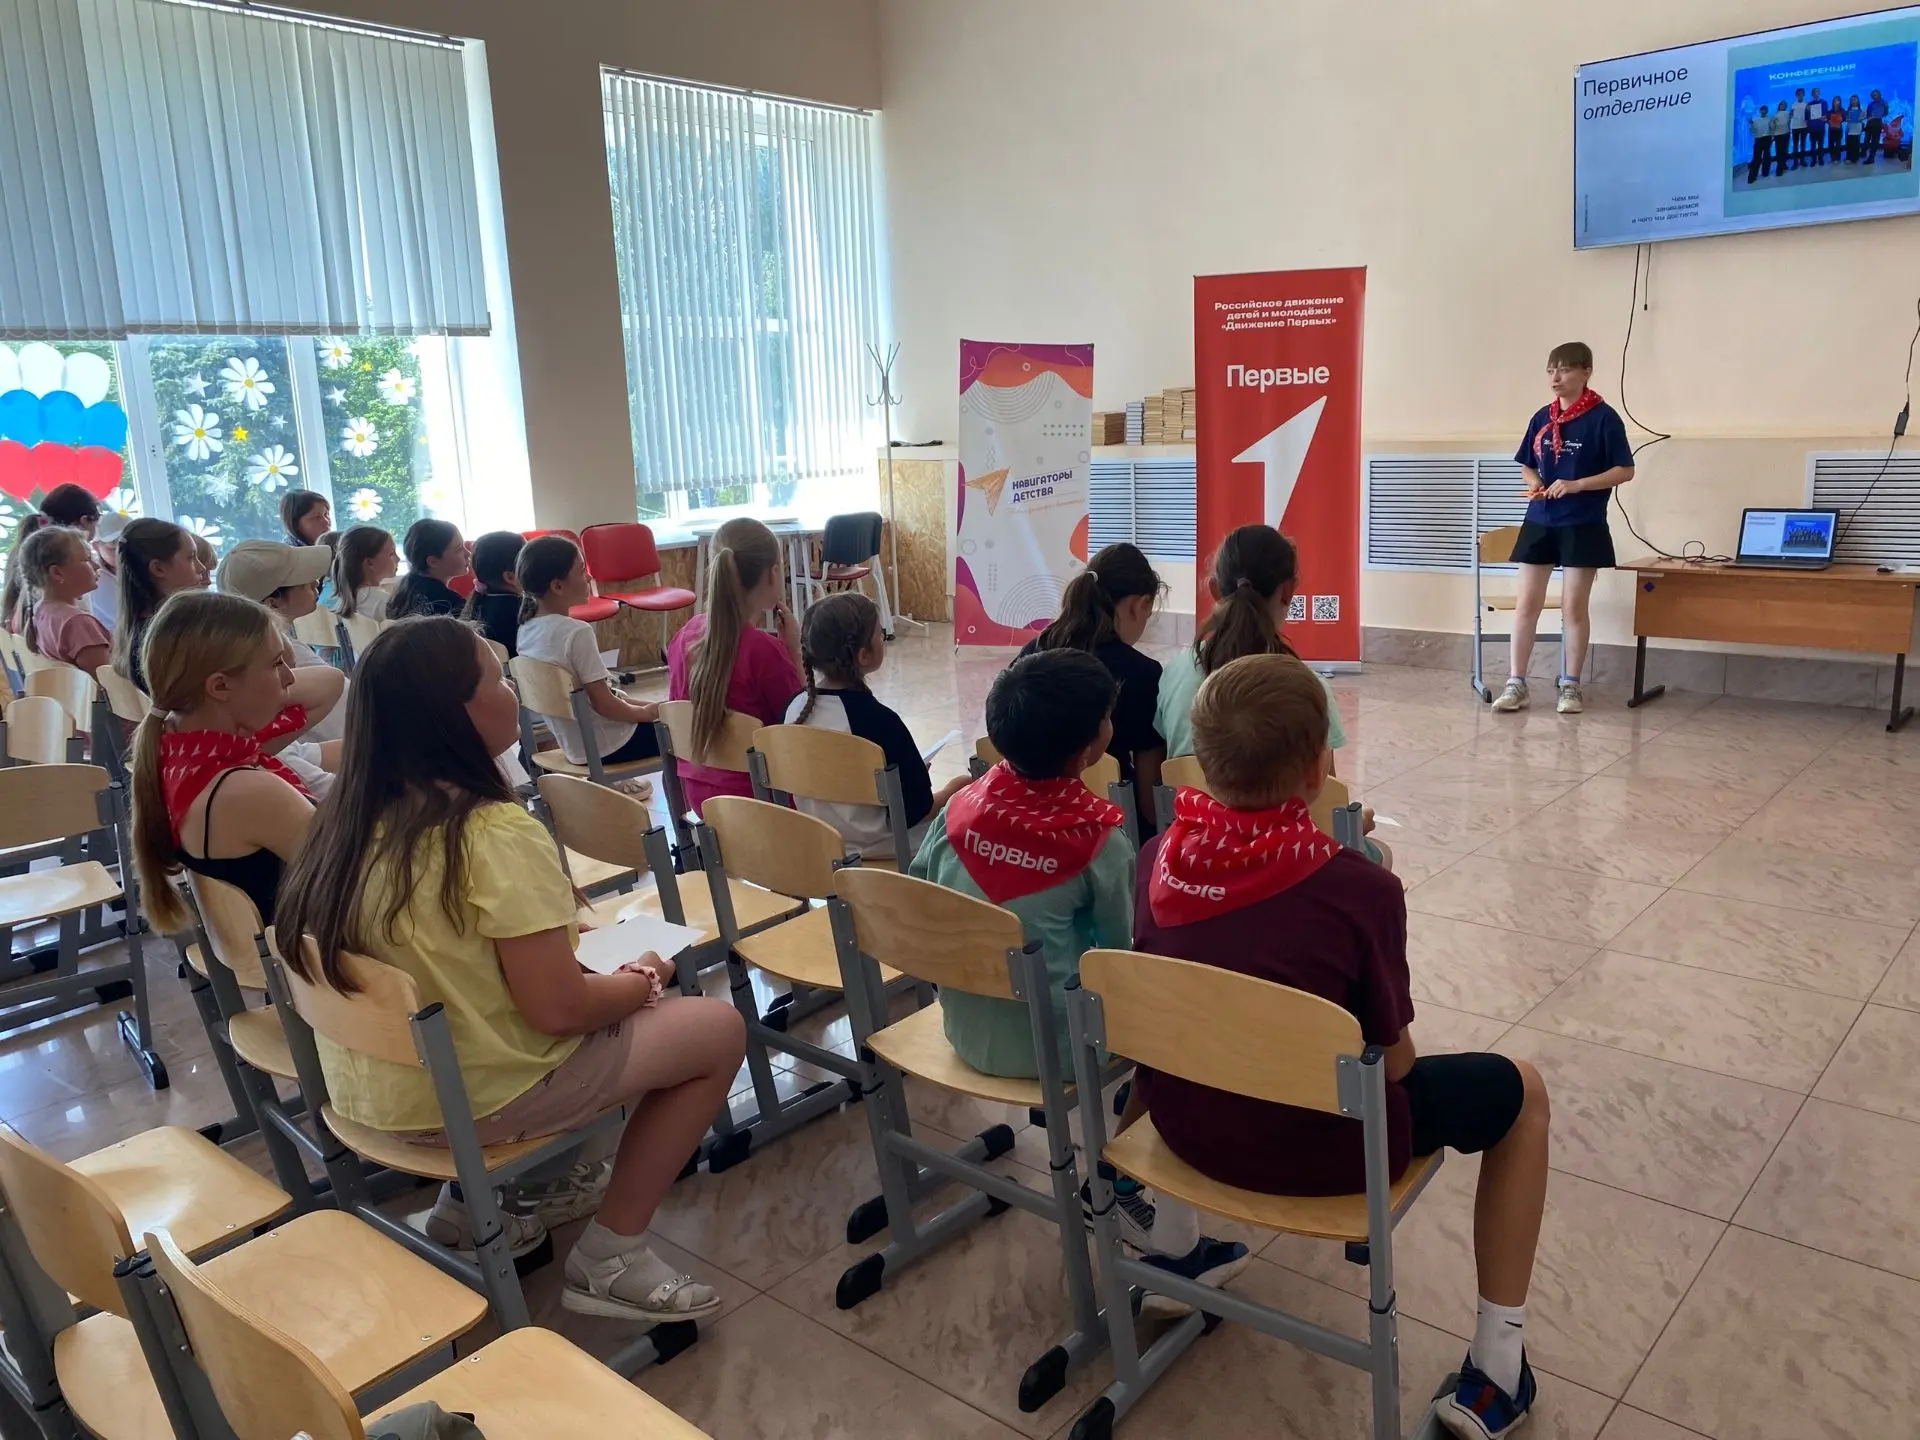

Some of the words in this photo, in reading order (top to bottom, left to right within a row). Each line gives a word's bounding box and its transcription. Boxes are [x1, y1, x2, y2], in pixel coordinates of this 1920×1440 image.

[1768, 63, 1856, 81] КОНФЕРЕНЦИЯ
[1583, 67, 1688, 97] Первичное
[1583, 91, 1692, 120] отделение
[1214, 299, 1283, 311] Российское
[1284, 296, 1344, 308] движение
[1226, 310, 1260, 321] детей
[1271, 307, 1332, 318] молодёжи
[1221, 319, 1285, 331] «Движение
[1287, 318, 1337, 328] Первых»
[1227, 364, 1330, 393] Первые
[1012, 469, 1073, 490] НАВИГАТОРЫ
[1013, 486, 1054, 504] ДЕТСТВА
[964, 828, 1058, 874] Первые
